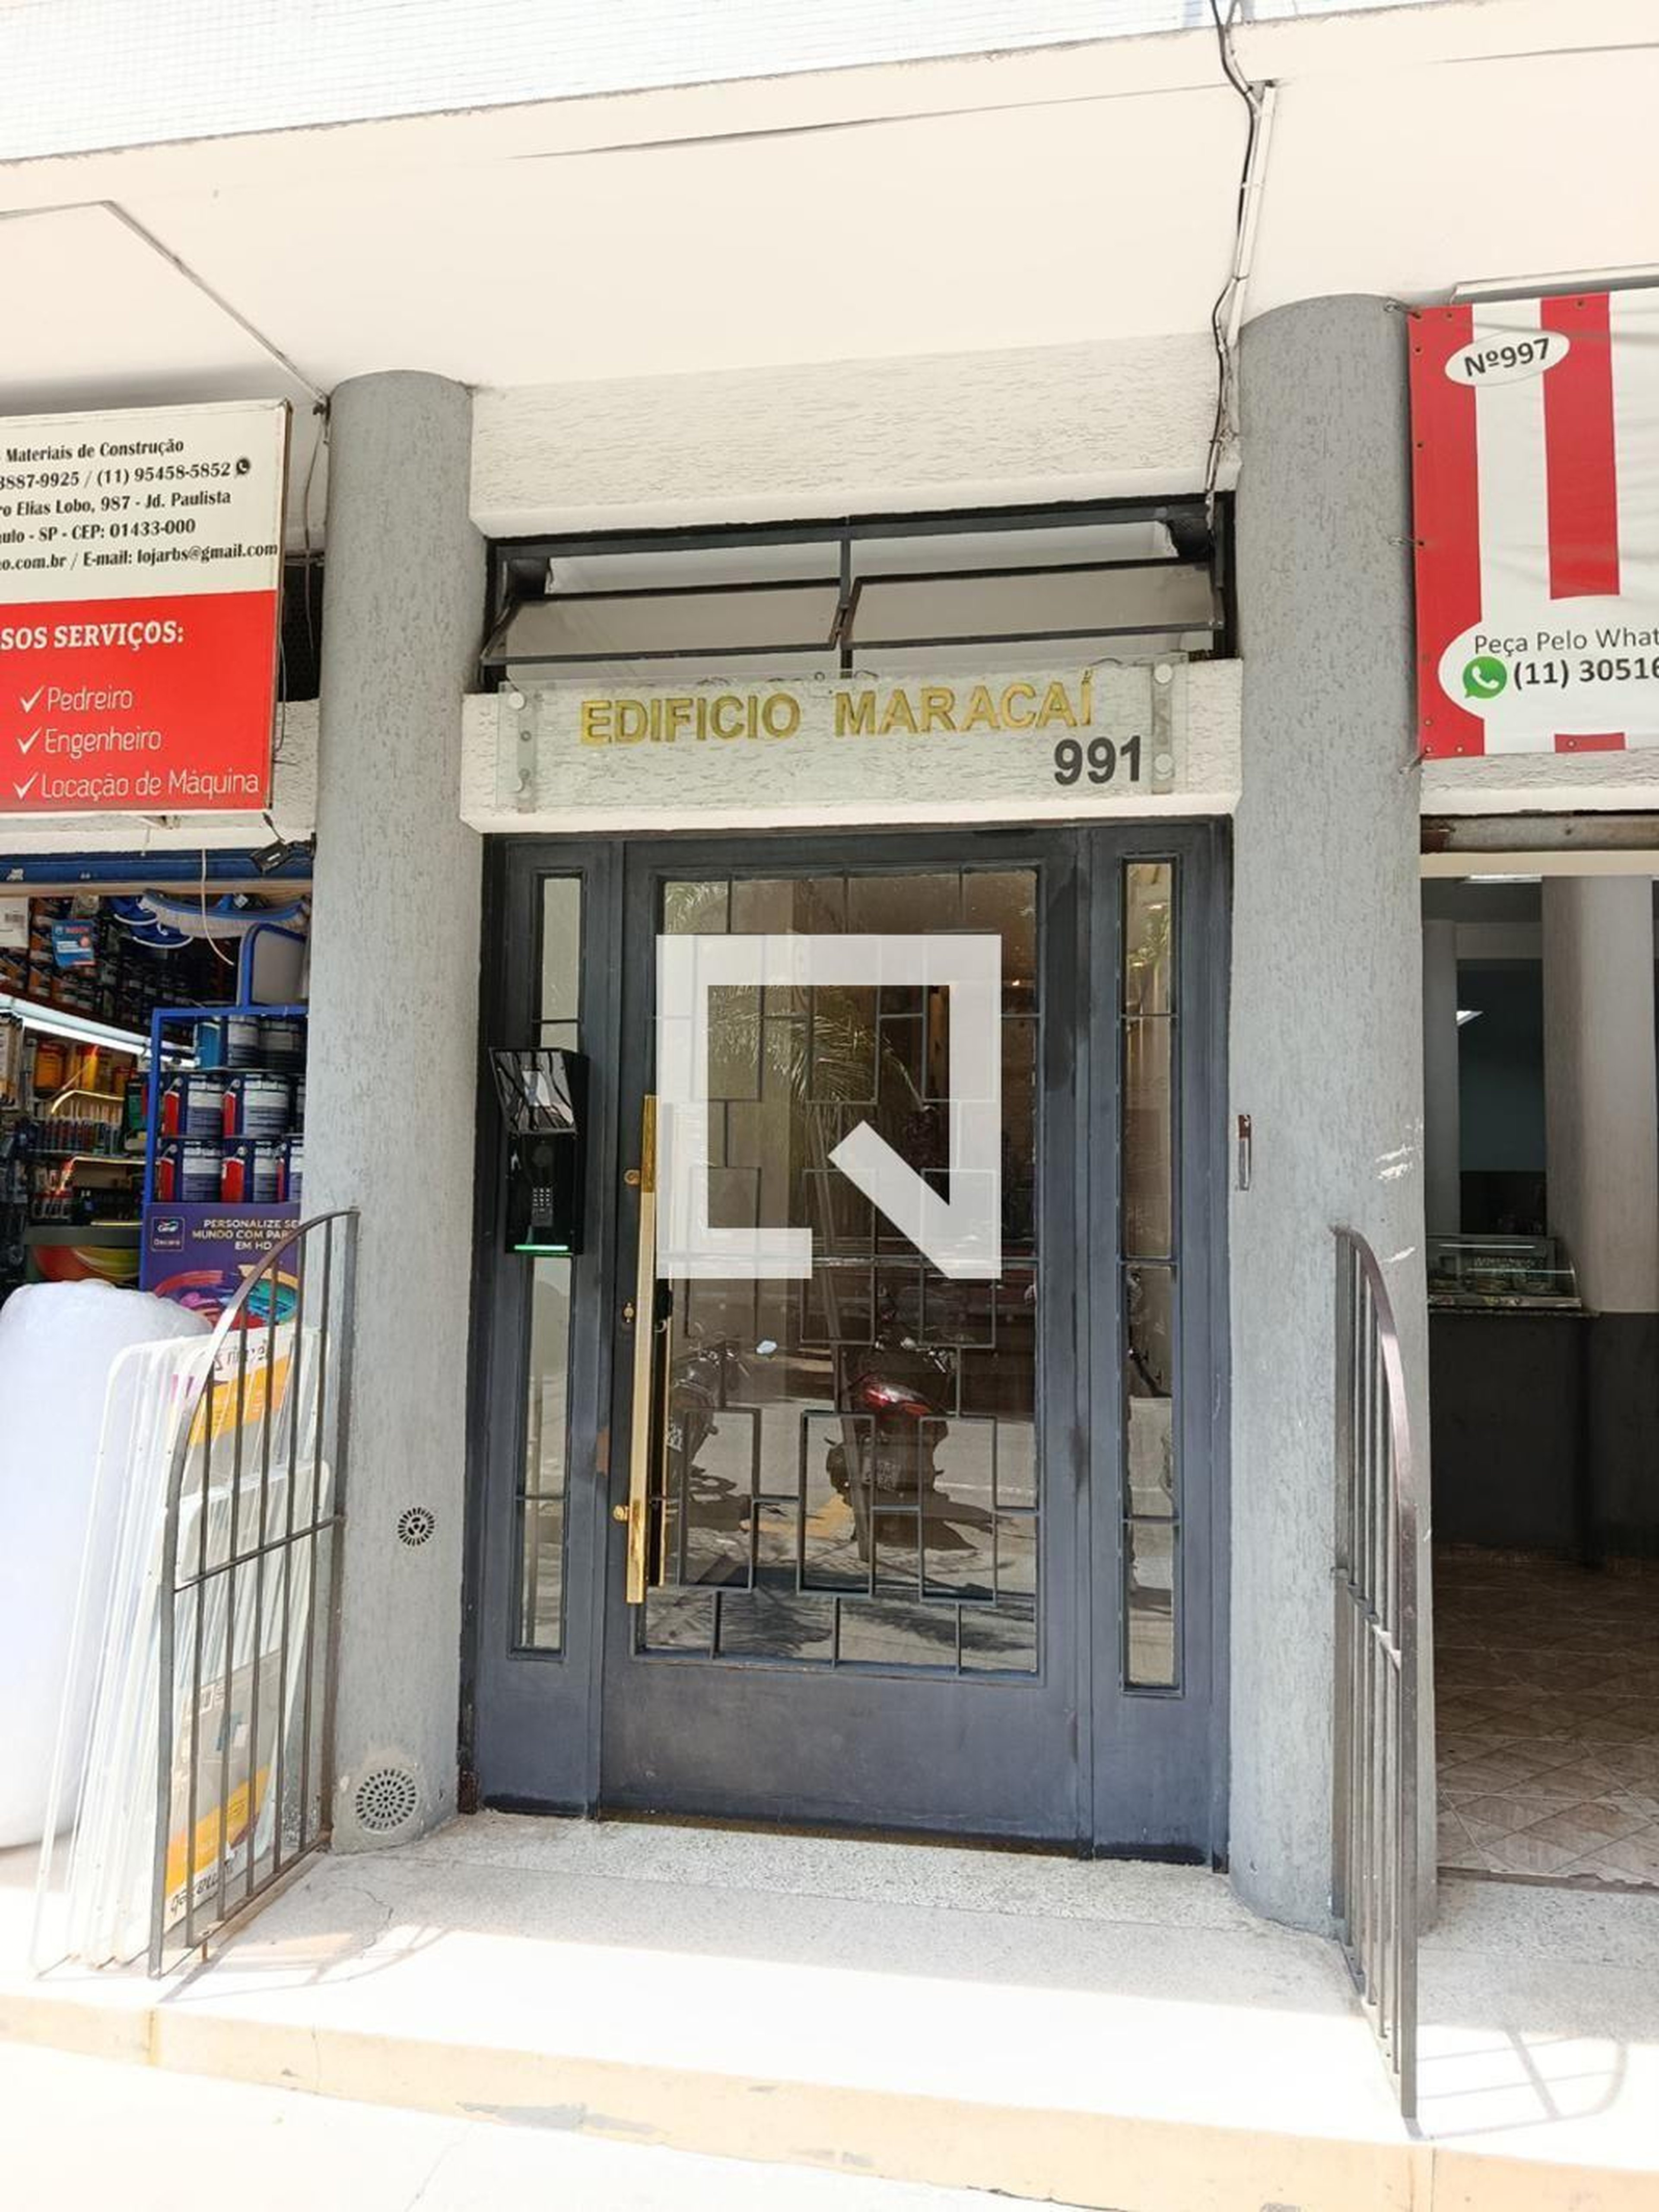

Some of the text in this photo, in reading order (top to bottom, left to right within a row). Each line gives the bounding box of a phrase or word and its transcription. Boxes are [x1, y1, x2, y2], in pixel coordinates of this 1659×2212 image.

[1464, 337, 1550, 376] Nº997
[6, 438, 184, 462] Materiais de Construção
[97, 469, 129, 487] (11)
[134, 461, 231, 482] 95458-5852
[17, 500, 51, 516] Elias
[56, 498, 95, 514] Lobo,
[101, 496, 130, 511] 987
[146, 494, 165, 509] Jd.
[171, 490, 231, 508] Paulista
[0, 529, 25, 544] ulo
[38, 526, 57, 541] SP
[72, 524, 105, 540] CEP:
[110, 519, 196, 538] 01433-000
[0, 554, 67, 570] o.com.br
[83, 550, 132, 567] E-mail:
[137, 543, 278, 567] lojarbs@gmail.com
[0, 621, 184, 651] SOS SERVIÇOS:
[1475, 627, 1659, 656] Peça Pelo What
[1514, 660, 1569, 690] (11)
[47, 686, 133, 713] Pedreiro
[581, 670, 1093, 745] EDIFICIO MARACAÍ
[45, 726, 161, 759] Engenheiro
[1054, 735, 1142, 785] 991
[41, 767, 259, 802] Locação de Máquina
[192, 1230, 233, 1239] MUNDO
[235, 1230, 263, 1239] COM
[203, 1219, 281, 1228] PERSONALIZE
[235, 1241, 272, 1250] EM HD
